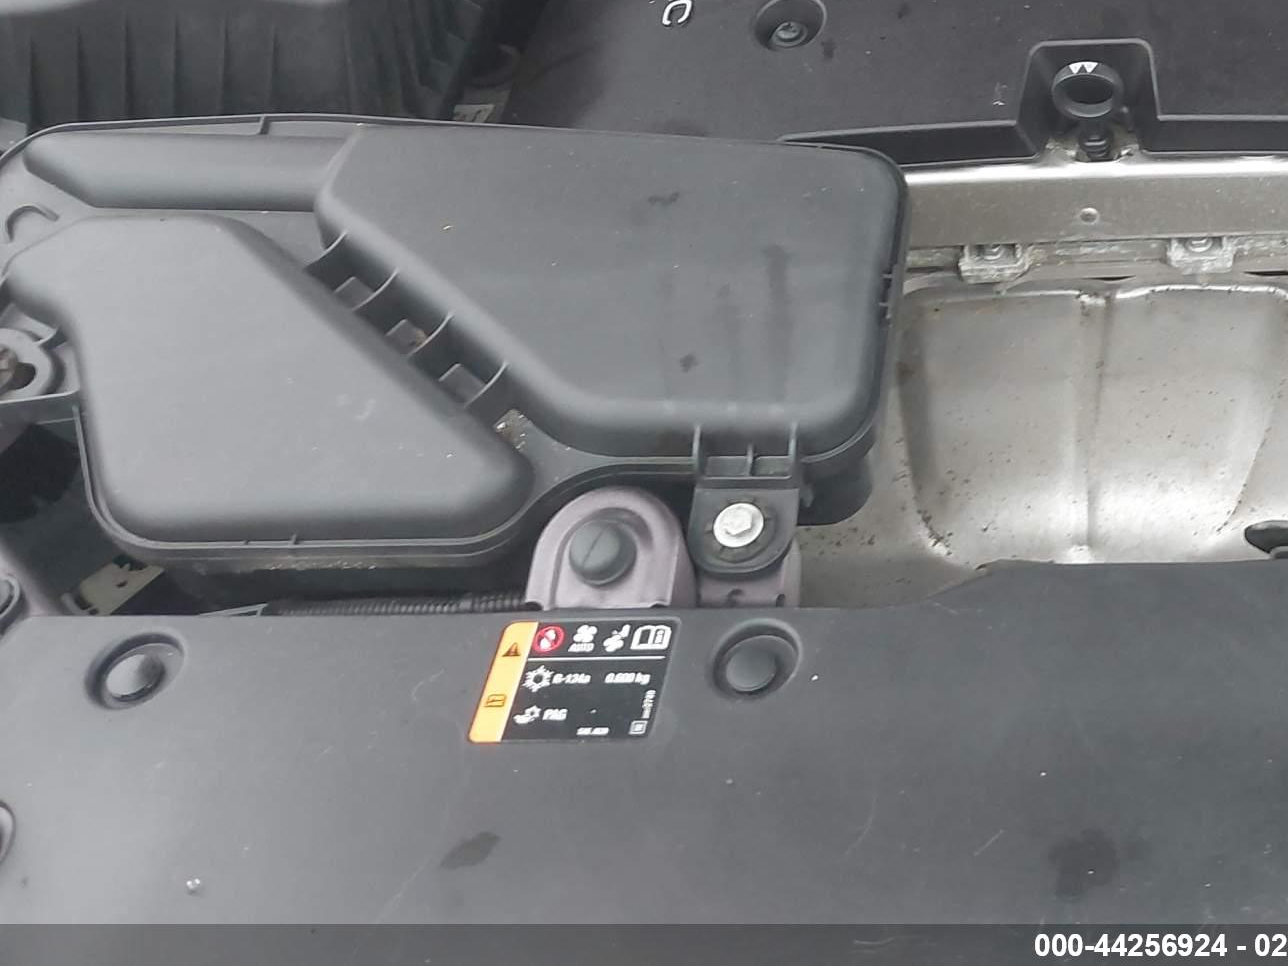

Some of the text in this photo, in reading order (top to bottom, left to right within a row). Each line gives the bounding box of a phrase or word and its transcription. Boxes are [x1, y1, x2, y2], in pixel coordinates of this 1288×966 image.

[568, 642, 595, 653] AUTO
[634, 672, 652, 685] kg
[542, 708, 569, 721] PAG
